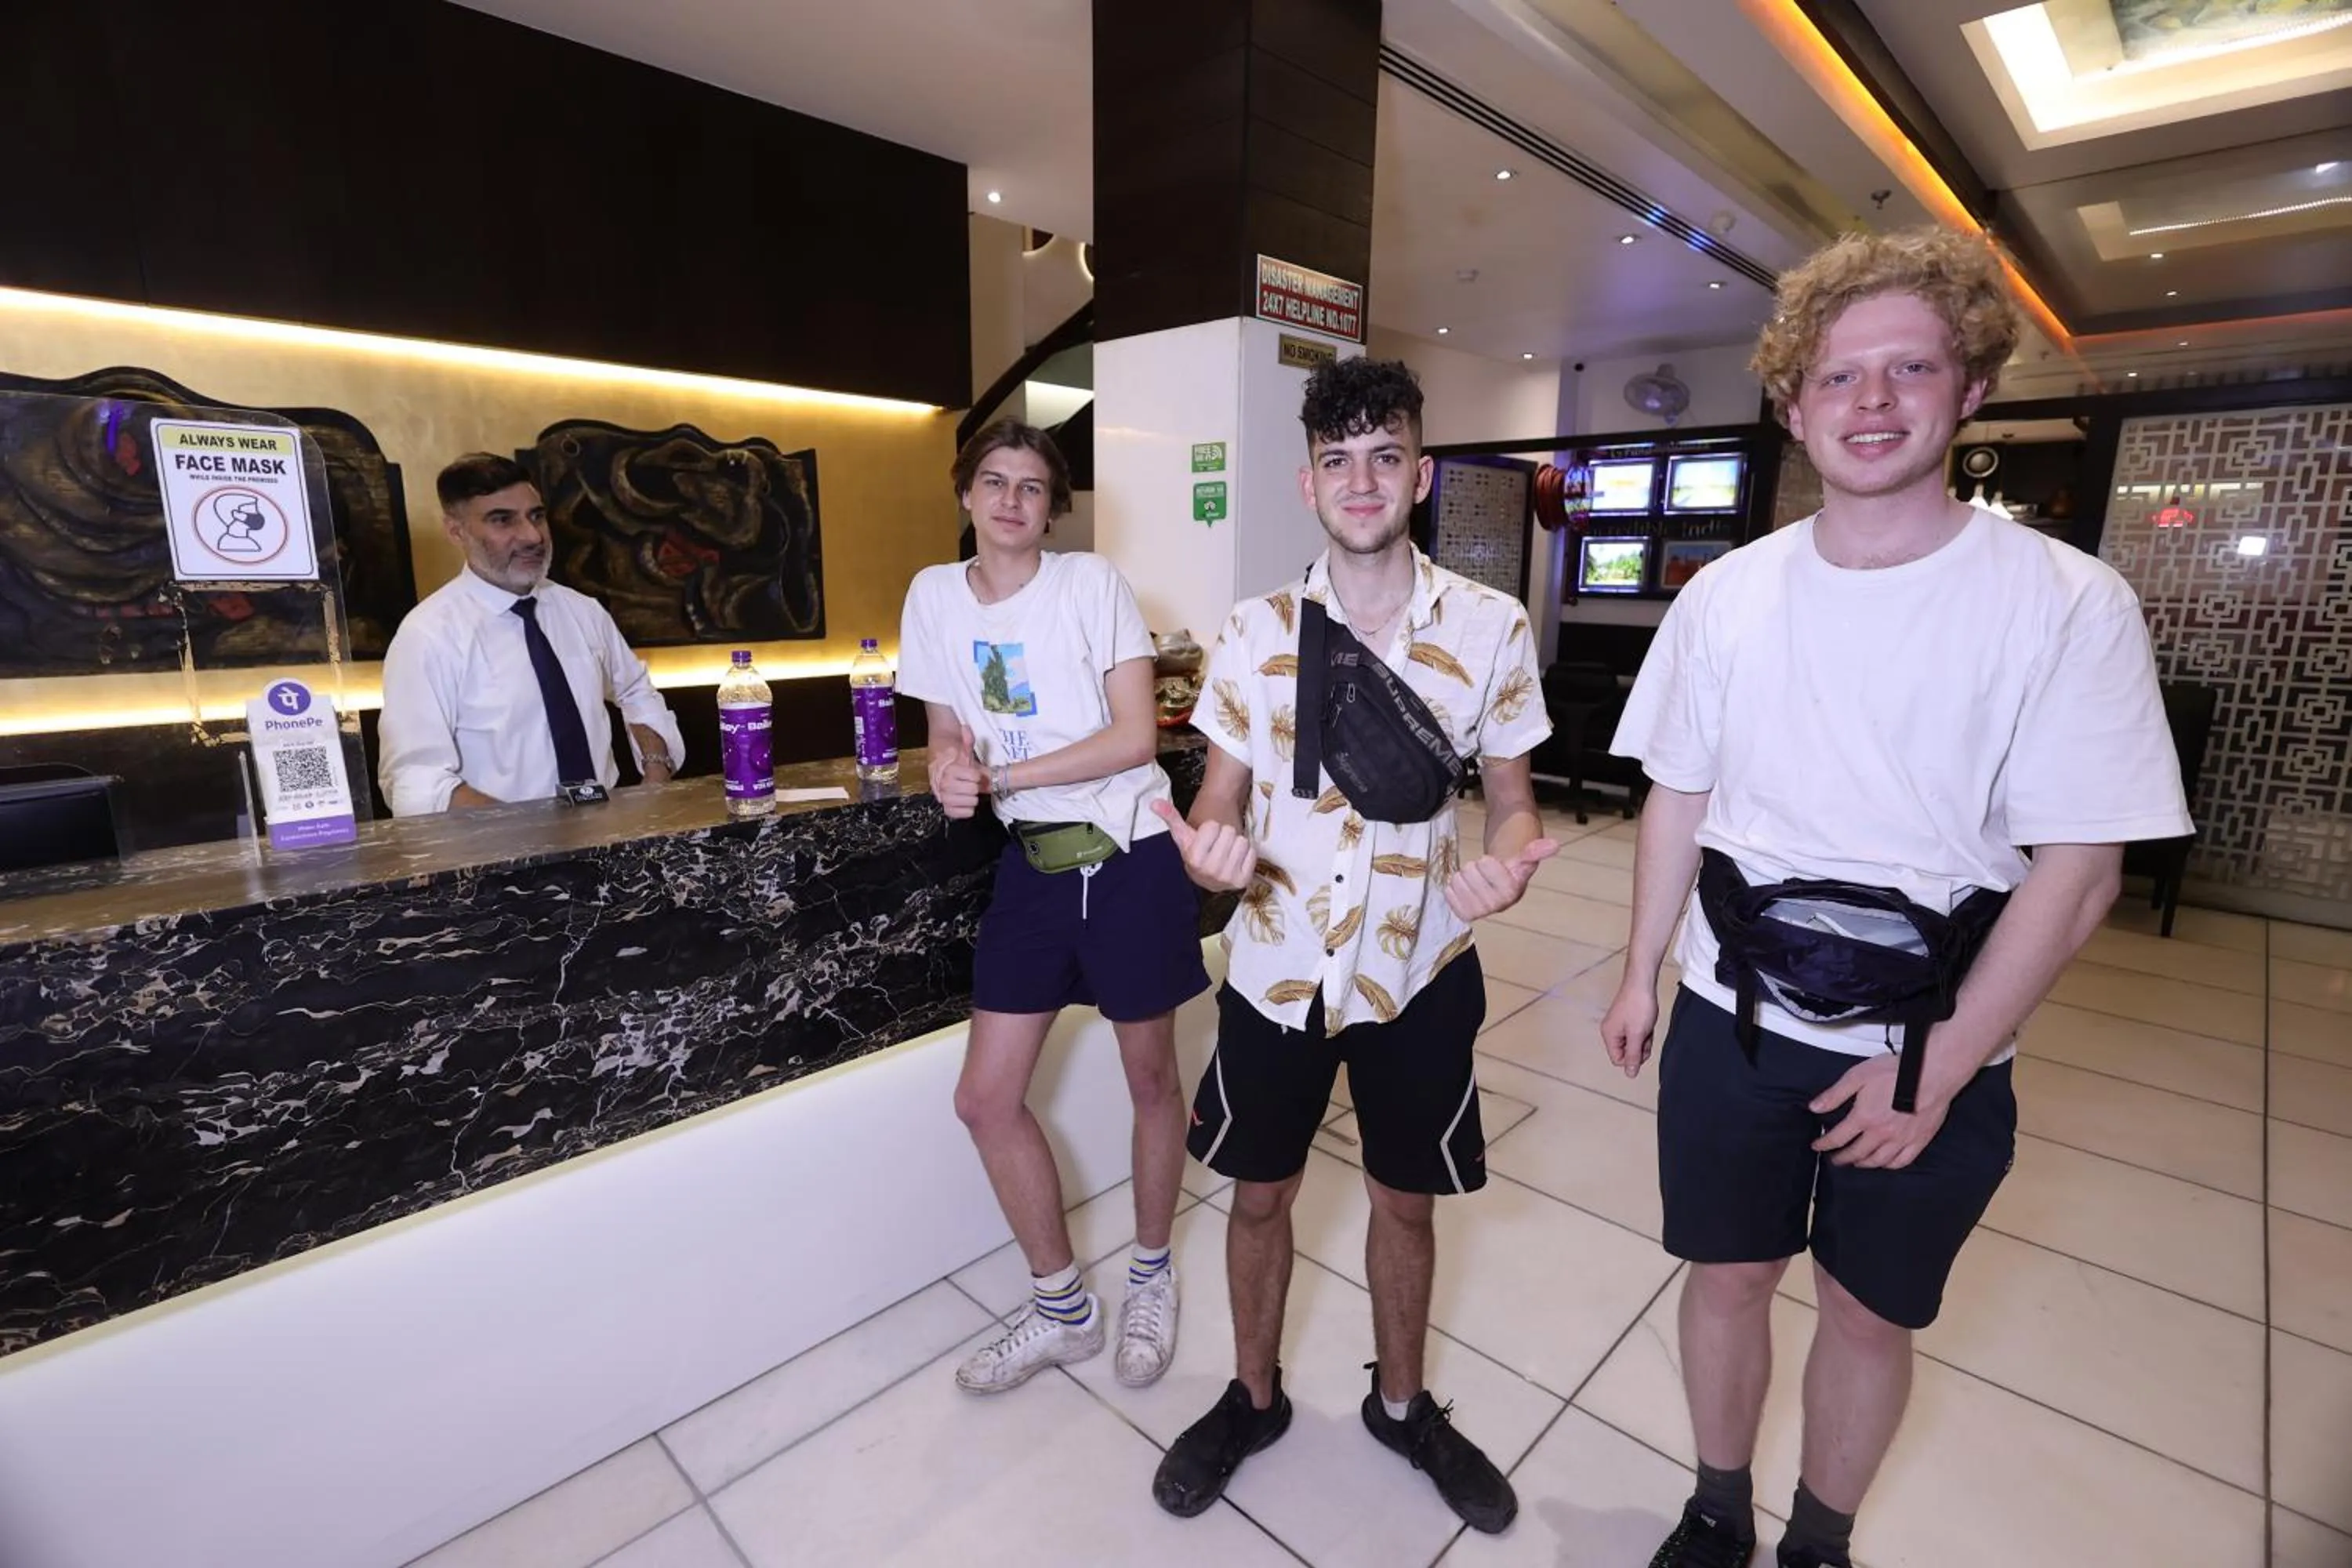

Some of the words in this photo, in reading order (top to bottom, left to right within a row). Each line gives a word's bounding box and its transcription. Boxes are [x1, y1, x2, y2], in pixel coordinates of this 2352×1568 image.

[1261, 262, 1304, 295] DISASTER
[1304, 274, 1359, 310] MANAGEMENT
[1285, 297, 1325, 326] HELPLINE
[179, 433, 235, 448] ALWAYS
[238, 437, 278, 451] WEAR
[175, 454, 227, 472] FACE
[232, 457, 287, 475] MASK
[264, 717, 324, 731] PhonePe
